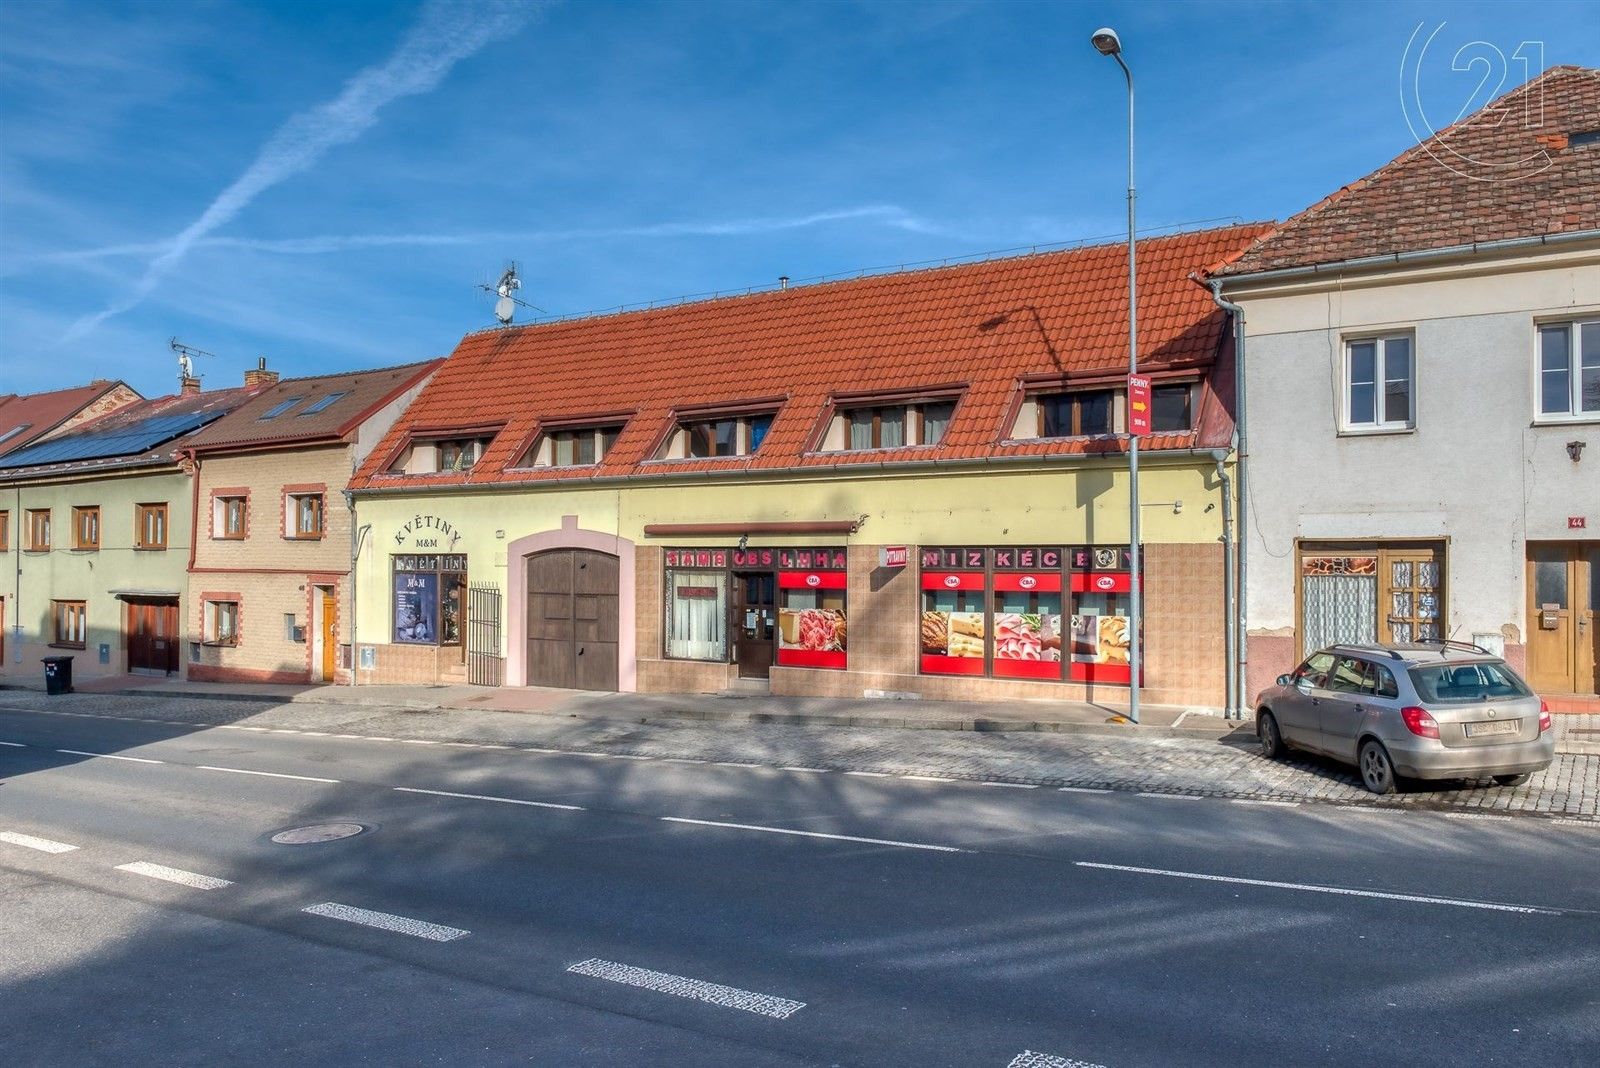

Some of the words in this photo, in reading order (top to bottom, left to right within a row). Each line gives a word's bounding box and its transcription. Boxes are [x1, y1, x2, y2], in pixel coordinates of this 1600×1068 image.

[1130, 377, 1149, 388] PENNY
[395, 515, 461, 545] KVĚTINY
[416, 539, 437, 547] M&M
[407, 578, 425, 588] M&M
